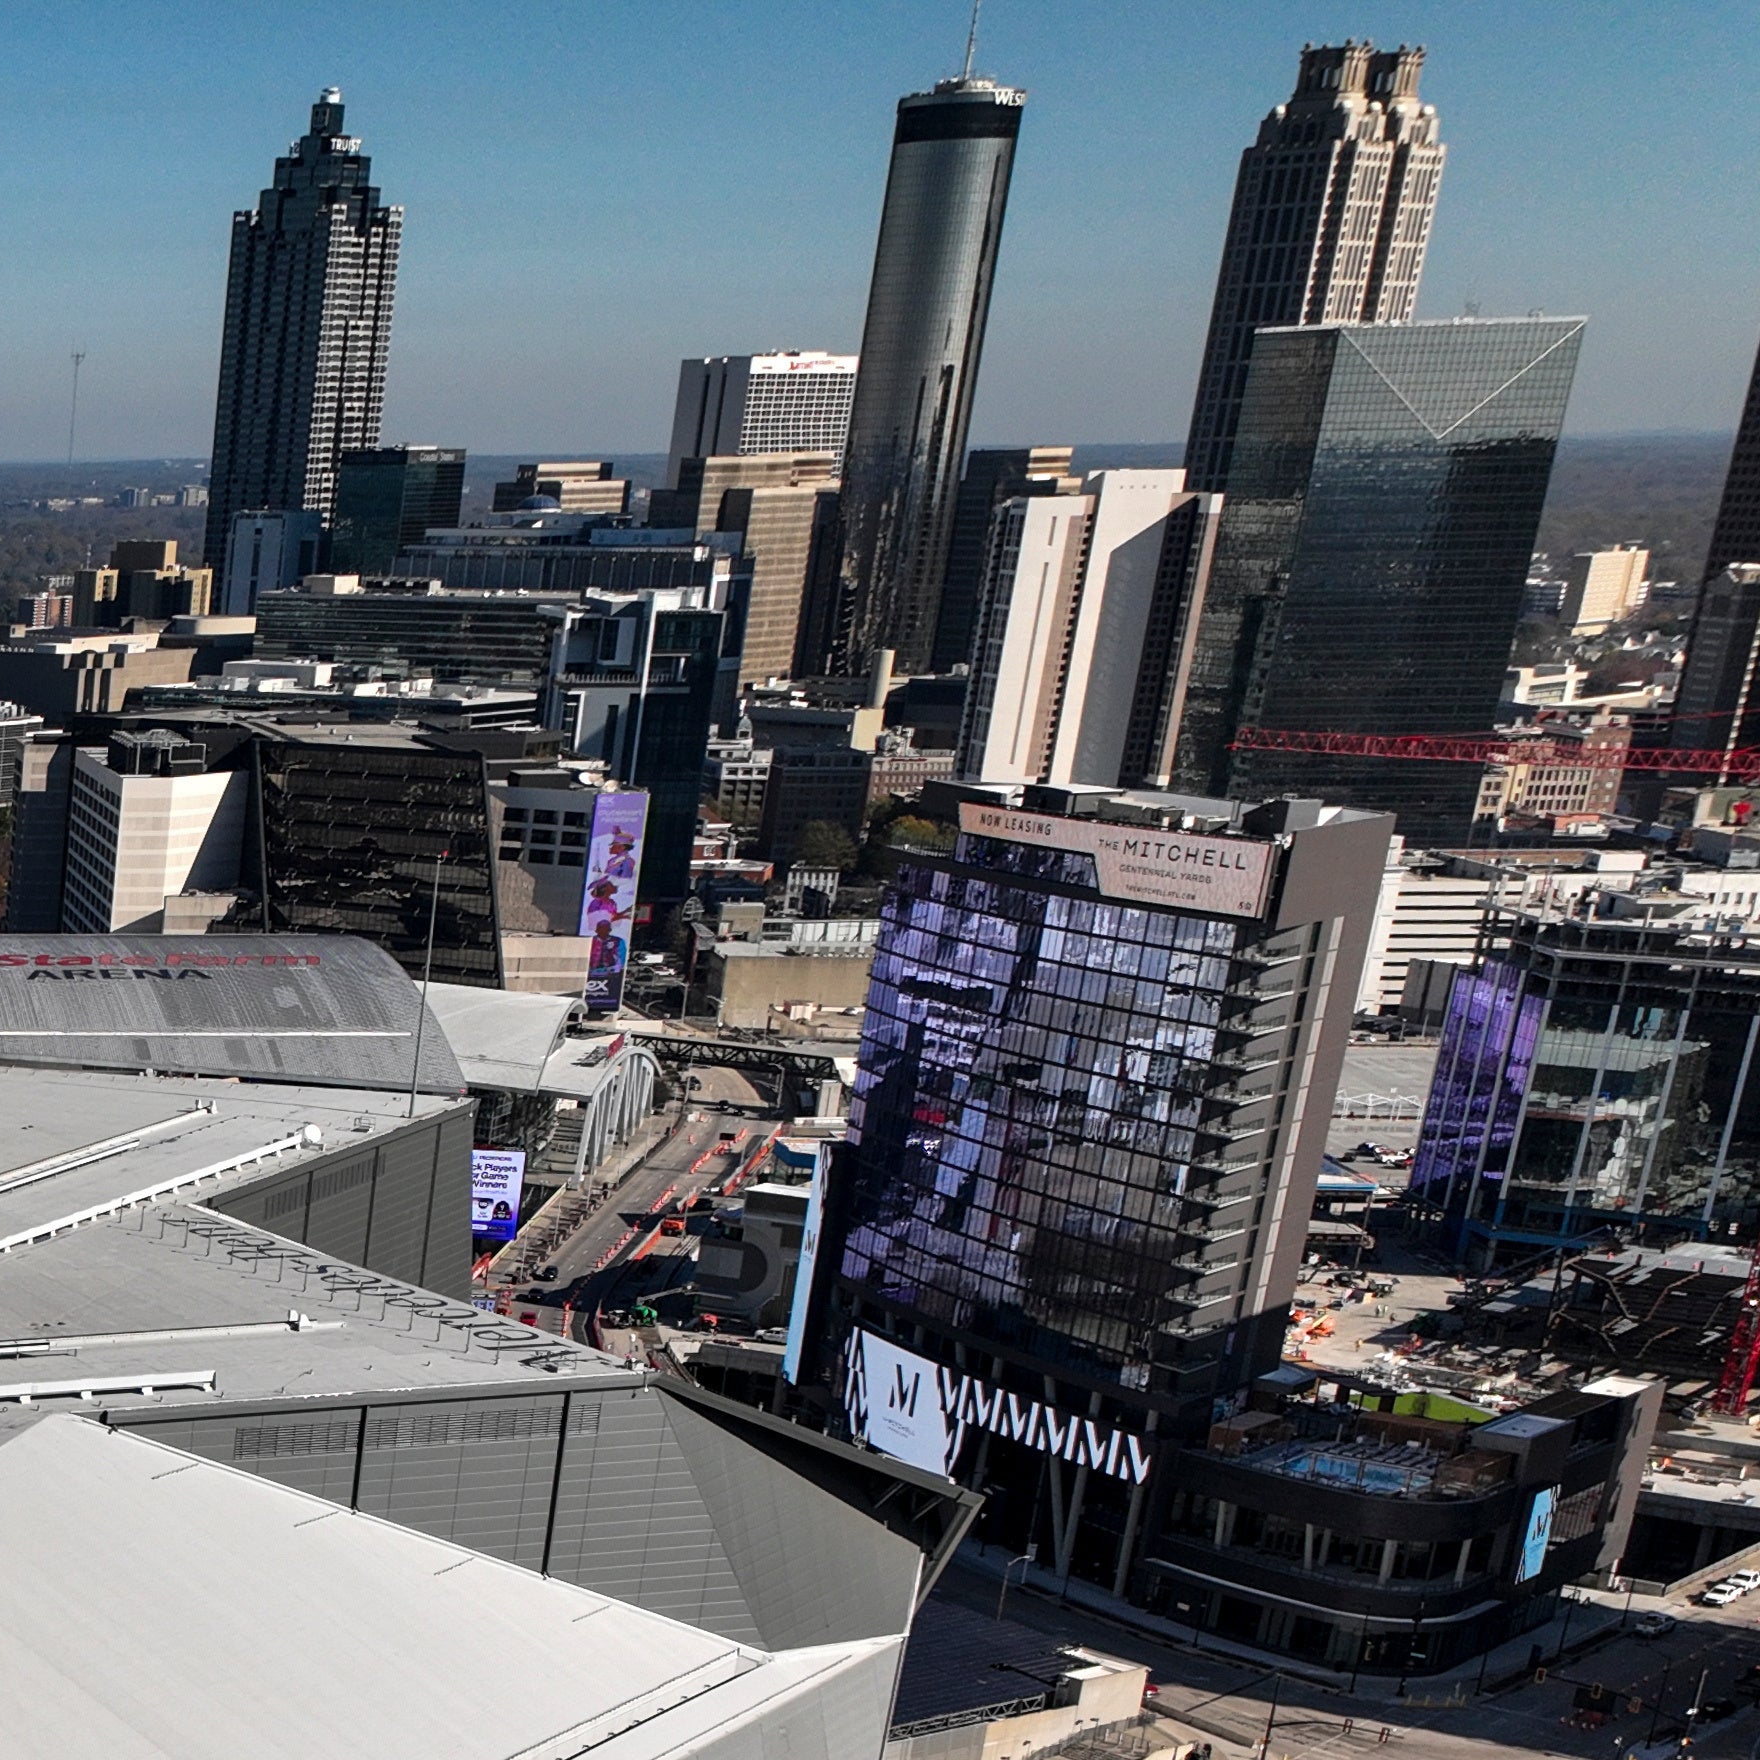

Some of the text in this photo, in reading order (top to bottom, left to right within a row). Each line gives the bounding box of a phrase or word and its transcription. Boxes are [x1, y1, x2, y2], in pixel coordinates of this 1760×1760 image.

[330, 137, 362, 152] TRUIST
[980, 813, 1052, 836] NOW LEASING
[1098, 839, 1247, 871] THE MITCHELL
[164, 953, 322, 967] Farm
[27, 968, 213, 981] ARENA
[484, 1163, 518, 1174] Players
[481, 1171, 509, 1181] Game
